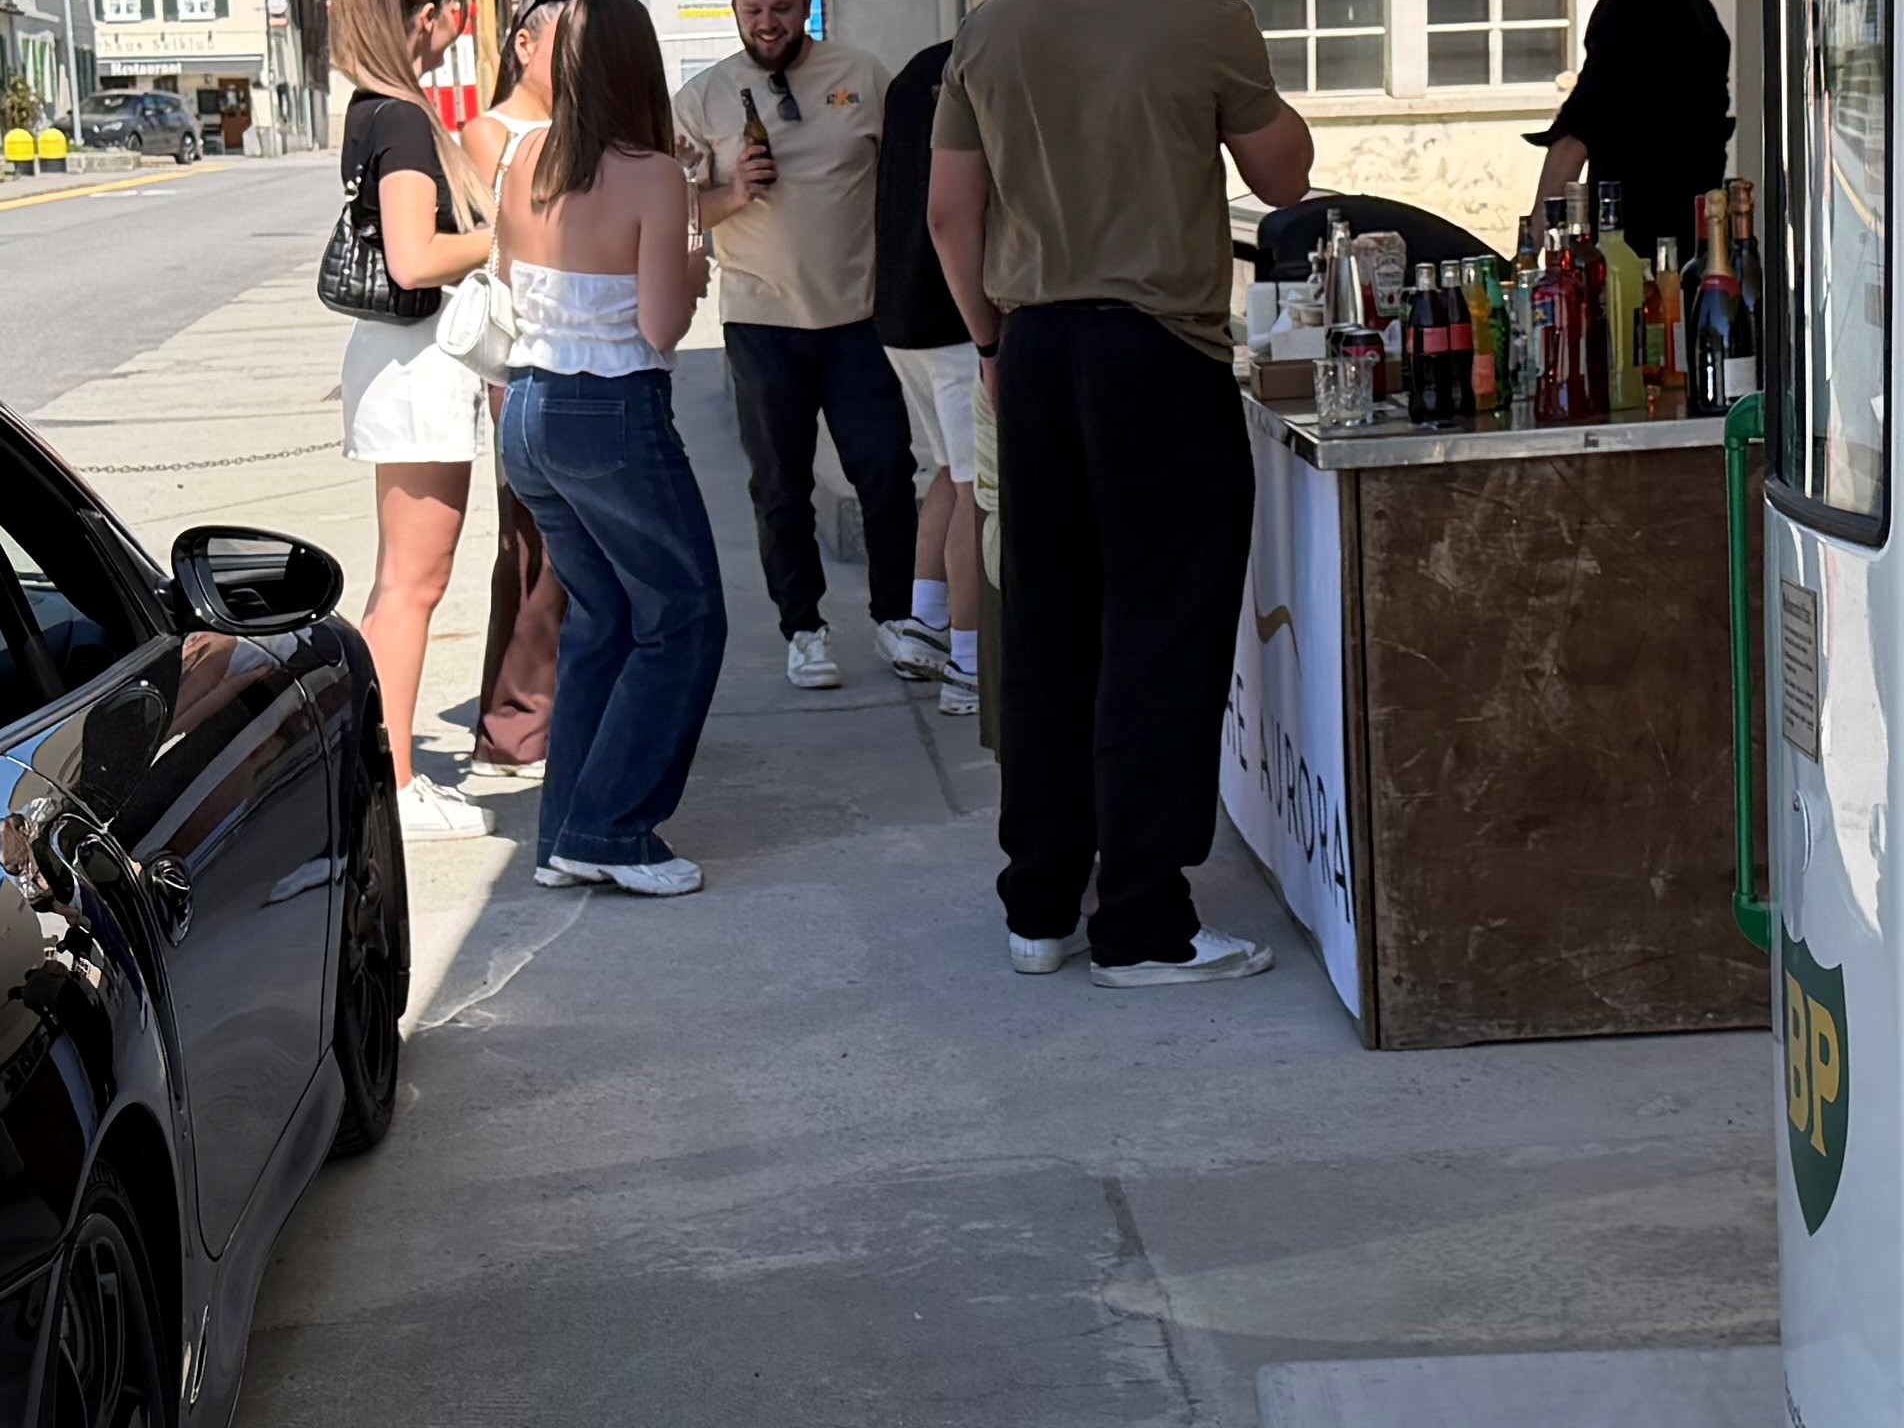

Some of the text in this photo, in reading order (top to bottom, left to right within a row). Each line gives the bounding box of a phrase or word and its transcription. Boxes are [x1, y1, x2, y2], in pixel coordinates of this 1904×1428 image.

[1226, 672, 1351, 924] HE AURORA
[1785, 969, 1840, 1157] BP
